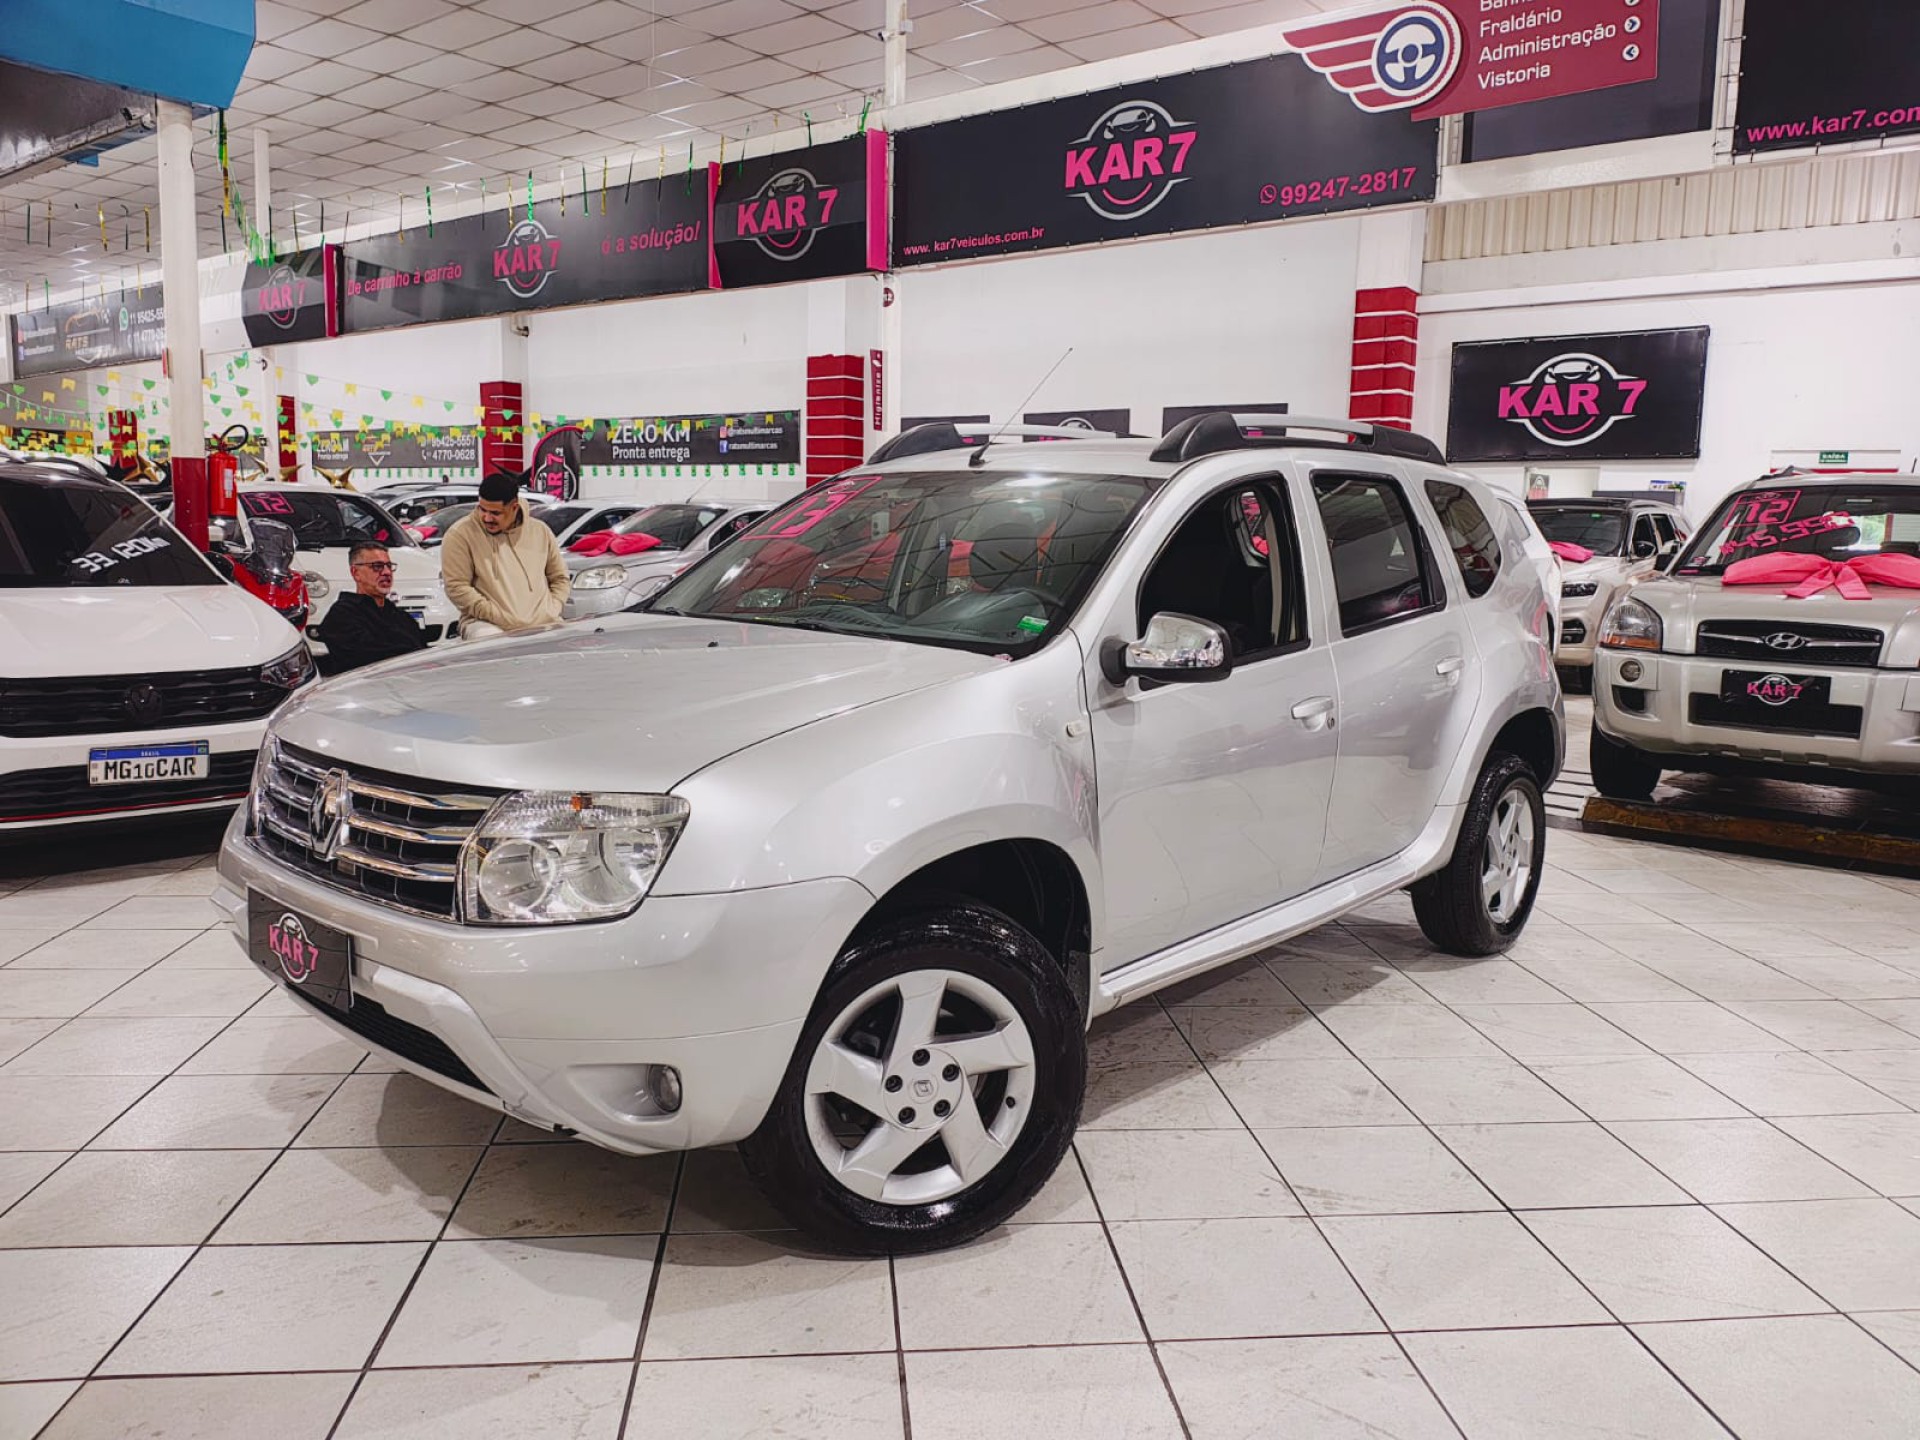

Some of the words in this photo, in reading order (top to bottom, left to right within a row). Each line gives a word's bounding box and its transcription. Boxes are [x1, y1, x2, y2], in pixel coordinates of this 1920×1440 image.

[1480, 7, 1562, 37] Fraldário
[1478, 24, 1616, 64] Administração
[1478, 63, 1551, 90] Vistoria
[1281, 167, 1417, 206] 99247-2817
[737, 194, 807, 236] KAR
[818, 188, 838, 224] 7
[616, 237, 625, 253] a
[629, 220, 701, 251] solução!
[934, 226, 1045, 252] kar7veiculos.com.br
[347, 279, 361, 297] De
[364, 270, 410, 293] carrinho
[424, 262, 463, 283] carrão
[1498, 383, 1600, 418] KAR
[1617, 379, 1648, 414] 7
[612, 425, 657, 444] ZERO
[663, 424, 691, 443] KM
[612, 446, 646, 459] Pronta
[649, 445, 690, 462] entrega
[257, 497, 290, 514] 12
[1746, 499, 1789, 523] 12
[1746, 682, 1787, 697] KAR
[1791, 685, 1802, 698] 7
[269, 924, 304, 968] KAR
[308, 945, 319, 971] 7
